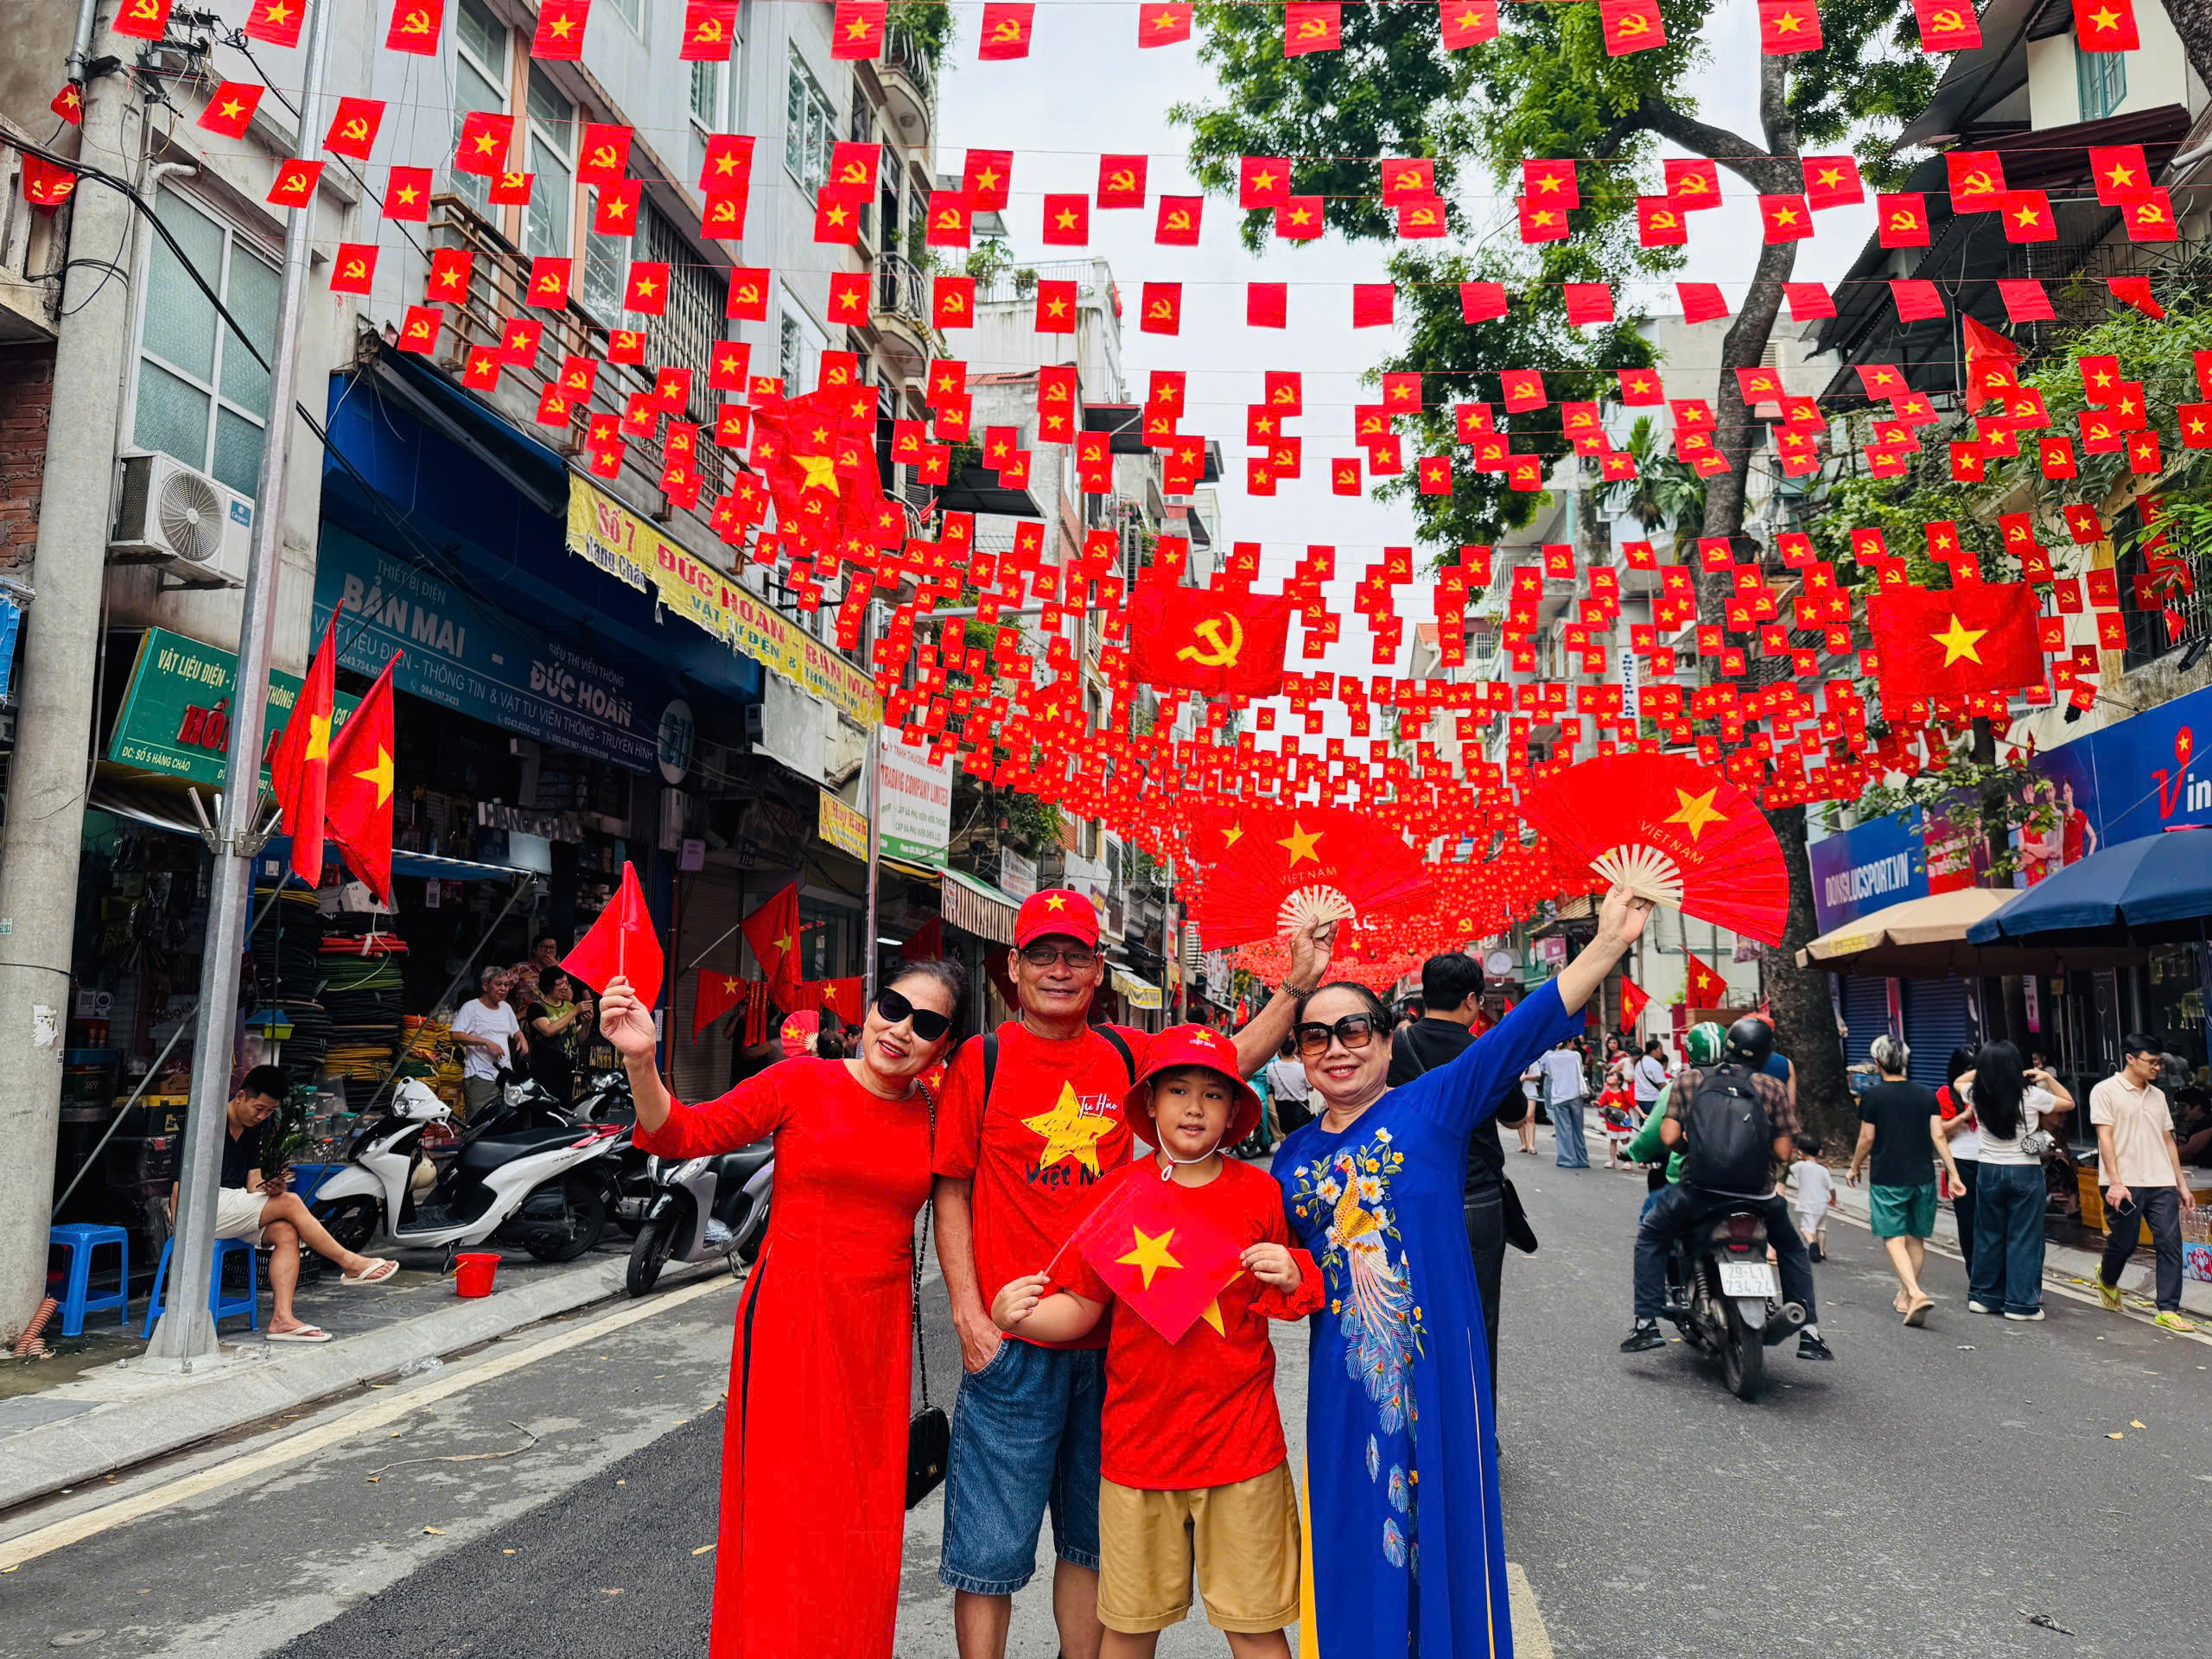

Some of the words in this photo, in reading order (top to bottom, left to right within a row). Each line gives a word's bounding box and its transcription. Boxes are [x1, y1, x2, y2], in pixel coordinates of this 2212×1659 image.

[625, 520, 636, 553] 7
[378, 559, 409, 584] THIẾT
[410, 576, 420, 596] BỊ
[422, 582, 446, 605] ĐIỆN
[658, 543, 714, 598] ĐỨC
[721, 587, 785, 645] HOÀN
[343, 573, 409, 634] BẢN
[411, 607, 466, 658] MAI
[158, 647, 180, 675] VẬT
[177, 655, 202, 682] LIỆU
[200, 663, 226, 690] ĐIỆN
[346, 625, 378, 652] LIỆU
[423, 659, 465, 691] THÔNG
[468, 678, 486, 700] TIN
[500, 691, 520, 713] VẬT
[523, 701, 538, 719] TƯ
[564, 717, 594, 741] THÔNG
[600, 665, 625, 688] THÔNG
[530, 659, 575, 704] ĐỨC
[577, 679, 633, 728] HOÀN
[136, 747, 146, 761] SỐ
[146, 752, 151, 762] 5
[152, 752, 172, 767] HÀNG
[171, 757, 191, 772] CHÁO
[905, 773, 930, 802] COMPANY
[930, 784, 948, 807] LIMITED
[1641, 819, 1671, 843] VIET
[1669, 839, 1706, 865] NAM
[1279, 872, 1305, 886] VIET
[1307, 865, 1338, 879] NAM
[1026, 1161, 1071, 1192] Việt
[1726, 1280, 1772, 1294] 734.24
